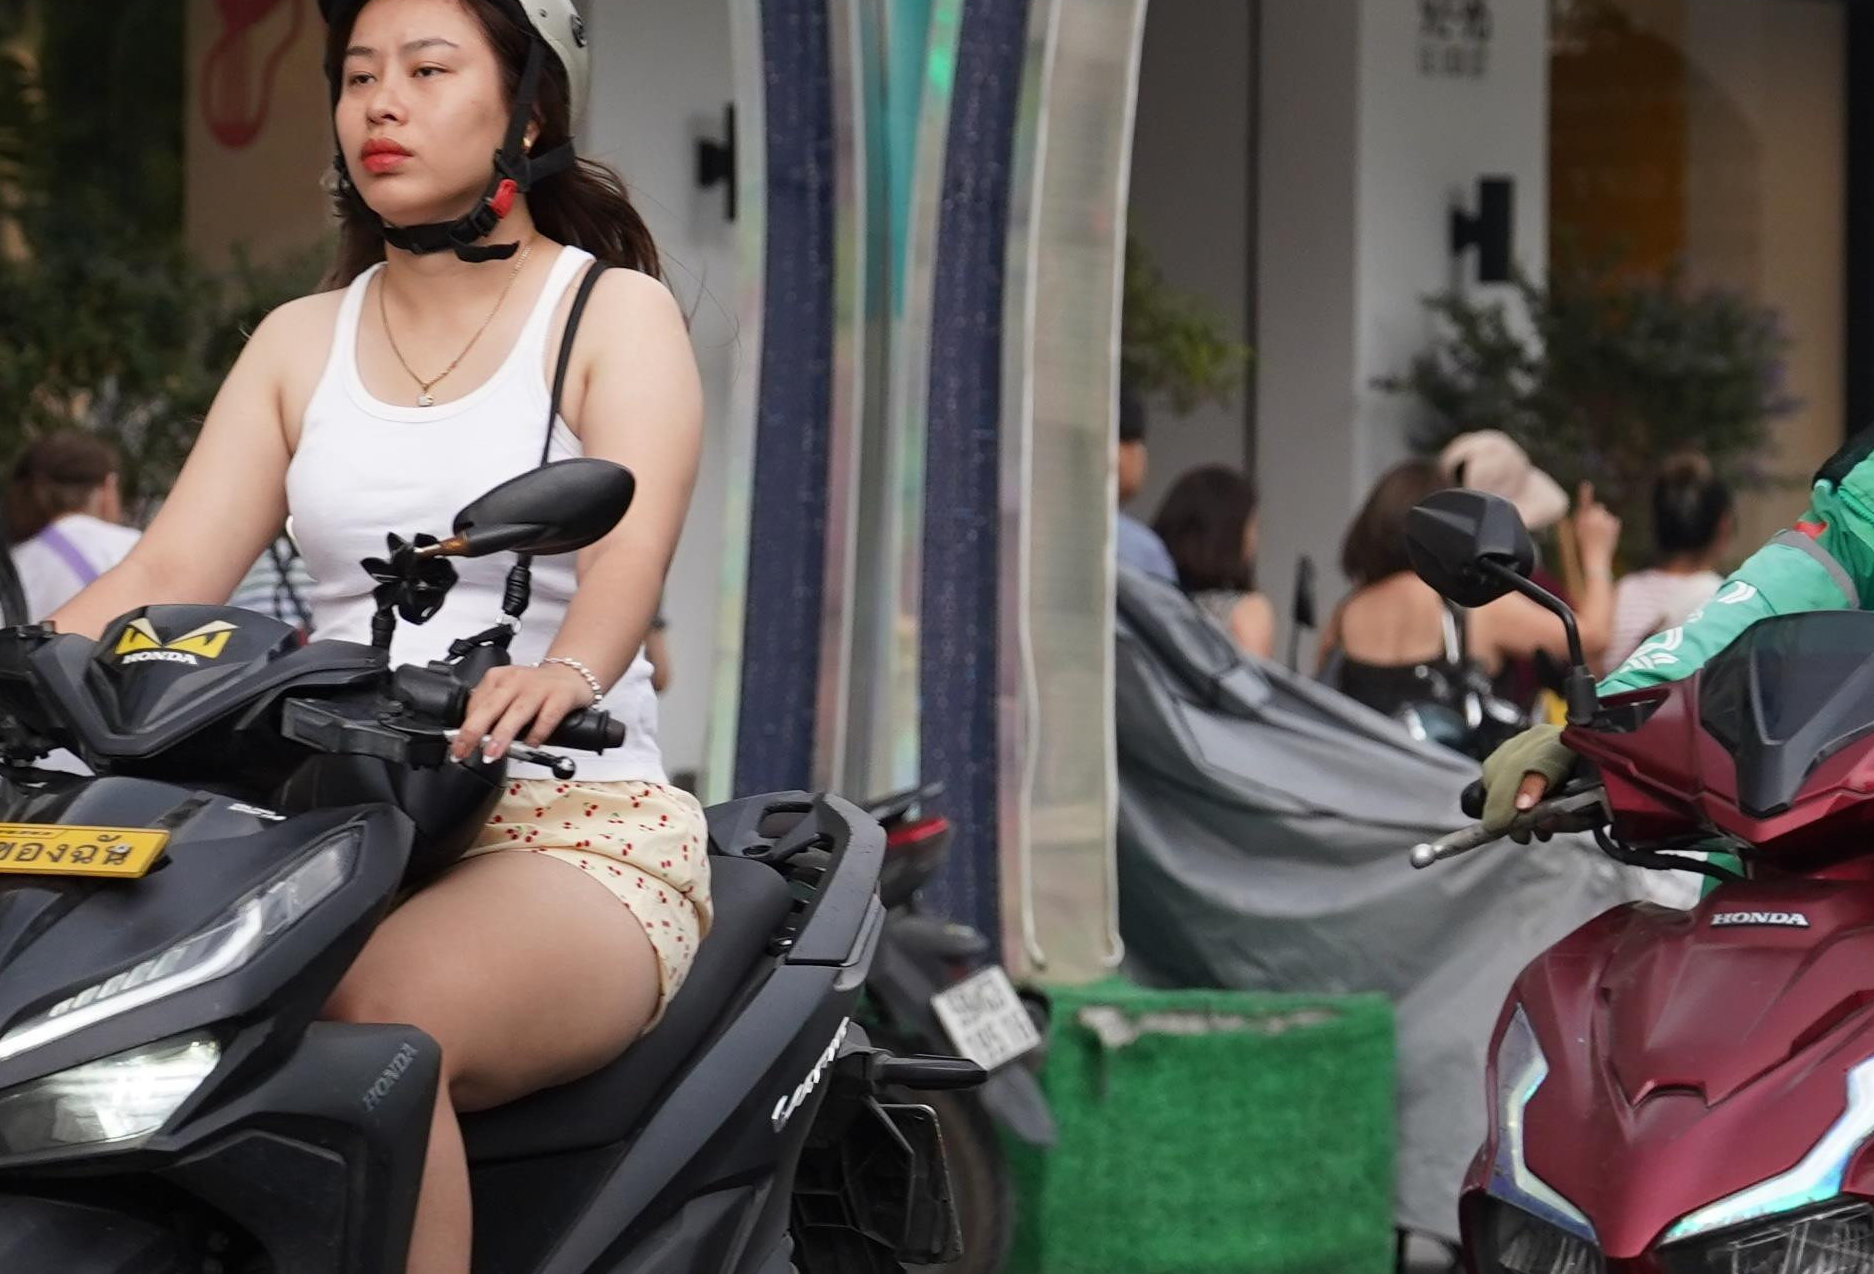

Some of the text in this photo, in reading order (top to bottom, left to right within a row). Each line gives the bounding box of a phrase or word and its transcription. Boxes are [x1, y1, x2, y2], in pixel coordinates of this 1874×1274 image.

[122, 650, 199, 665] HONDA
[1710, 911, 1810, 927] HONDA
[362, 1042, 420, 1112] HONDA
